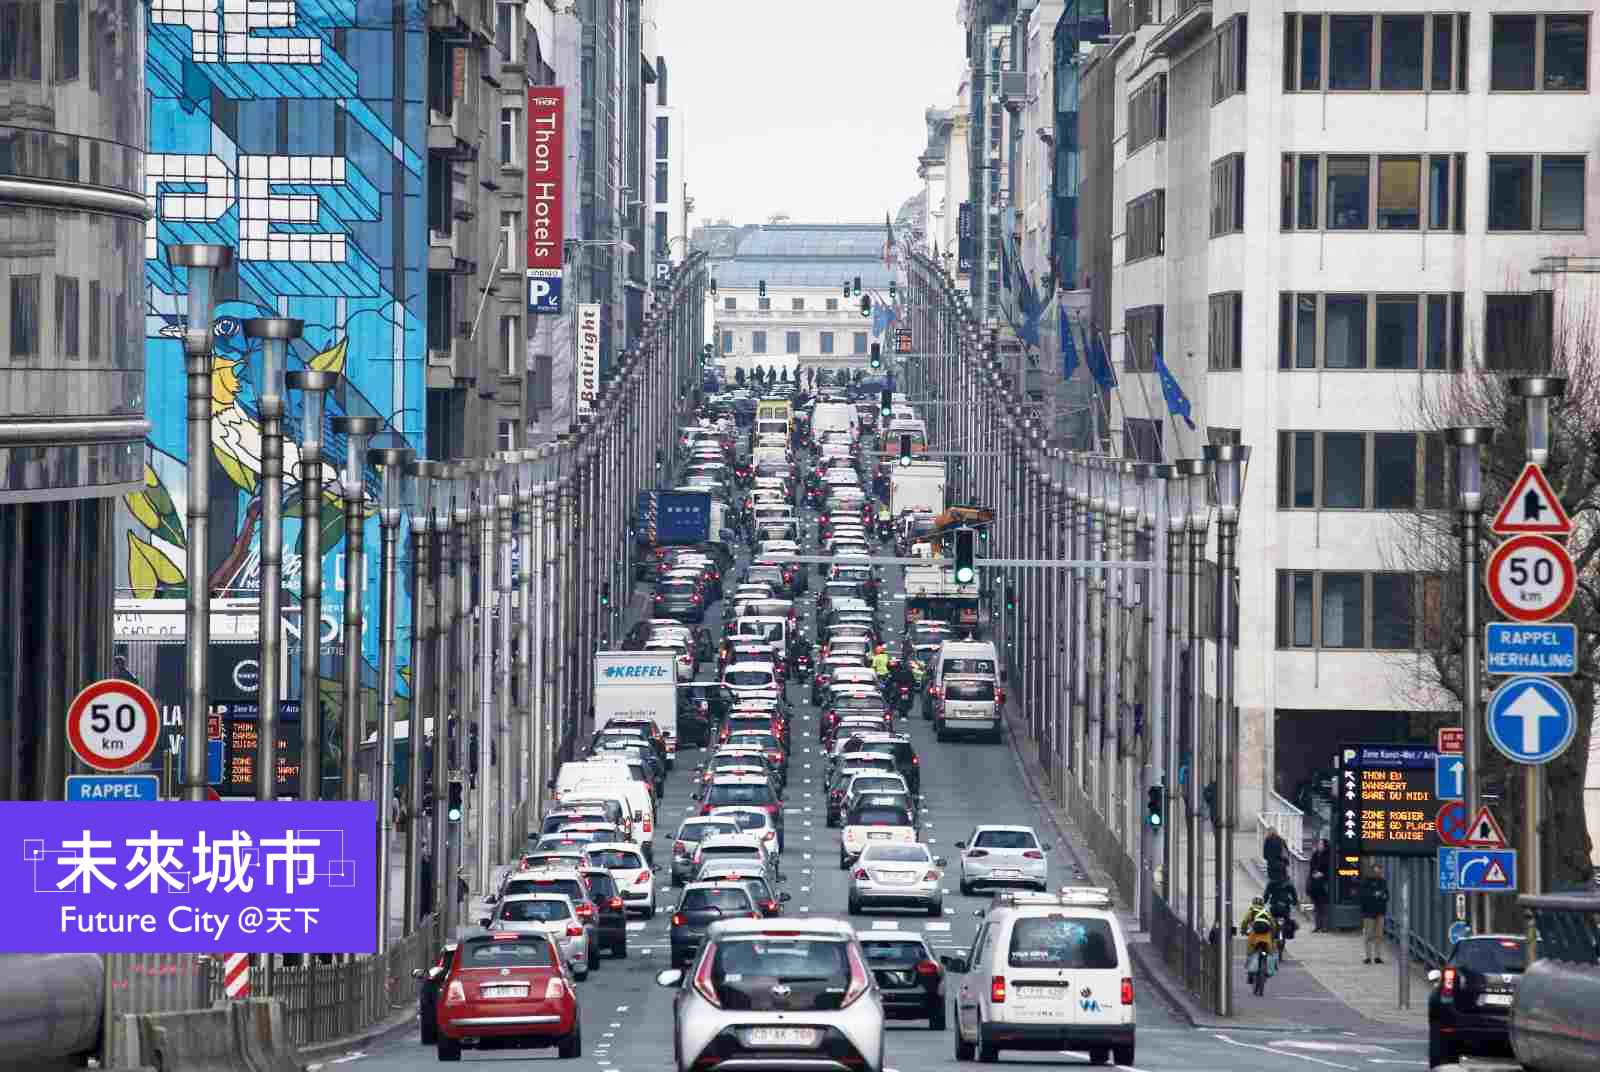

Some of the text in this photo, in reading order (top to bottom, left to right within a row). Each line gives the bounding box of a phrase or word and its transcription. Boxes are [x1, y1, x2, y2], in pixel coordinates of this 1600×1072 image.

[535, 112, 556, 257] Thon Hotels
[530, 280, 550, 305] P
[581, 311, 597, 401] Batiright
[1509, 557, 1554, 587] 50
[1520, 591, 1542, 601] km
[1501, 631, 1561, 646] RAPPEL
[1490, 652, 1574, 667] HERHALING
[91, 704, 136, 733] 50
[102, 738, 124, 750] km
[1344, 749, 1356, 764] P
[1362, 771, 1386, 781] THON
[80, 784, 143, 799] RAPPEL
[1361, 781, 1408, 791] DANSAERT
[1361, 791, 1429, 801] GARE DU MIDI
[1361, 811, 1425, 821] ZONE ROGIER
[1361, 820, 1385, 830] ZONE
[1406, 821, 1436, 831] PLACE
[1361, 830, 1425, 841] ZONE LOUISE
